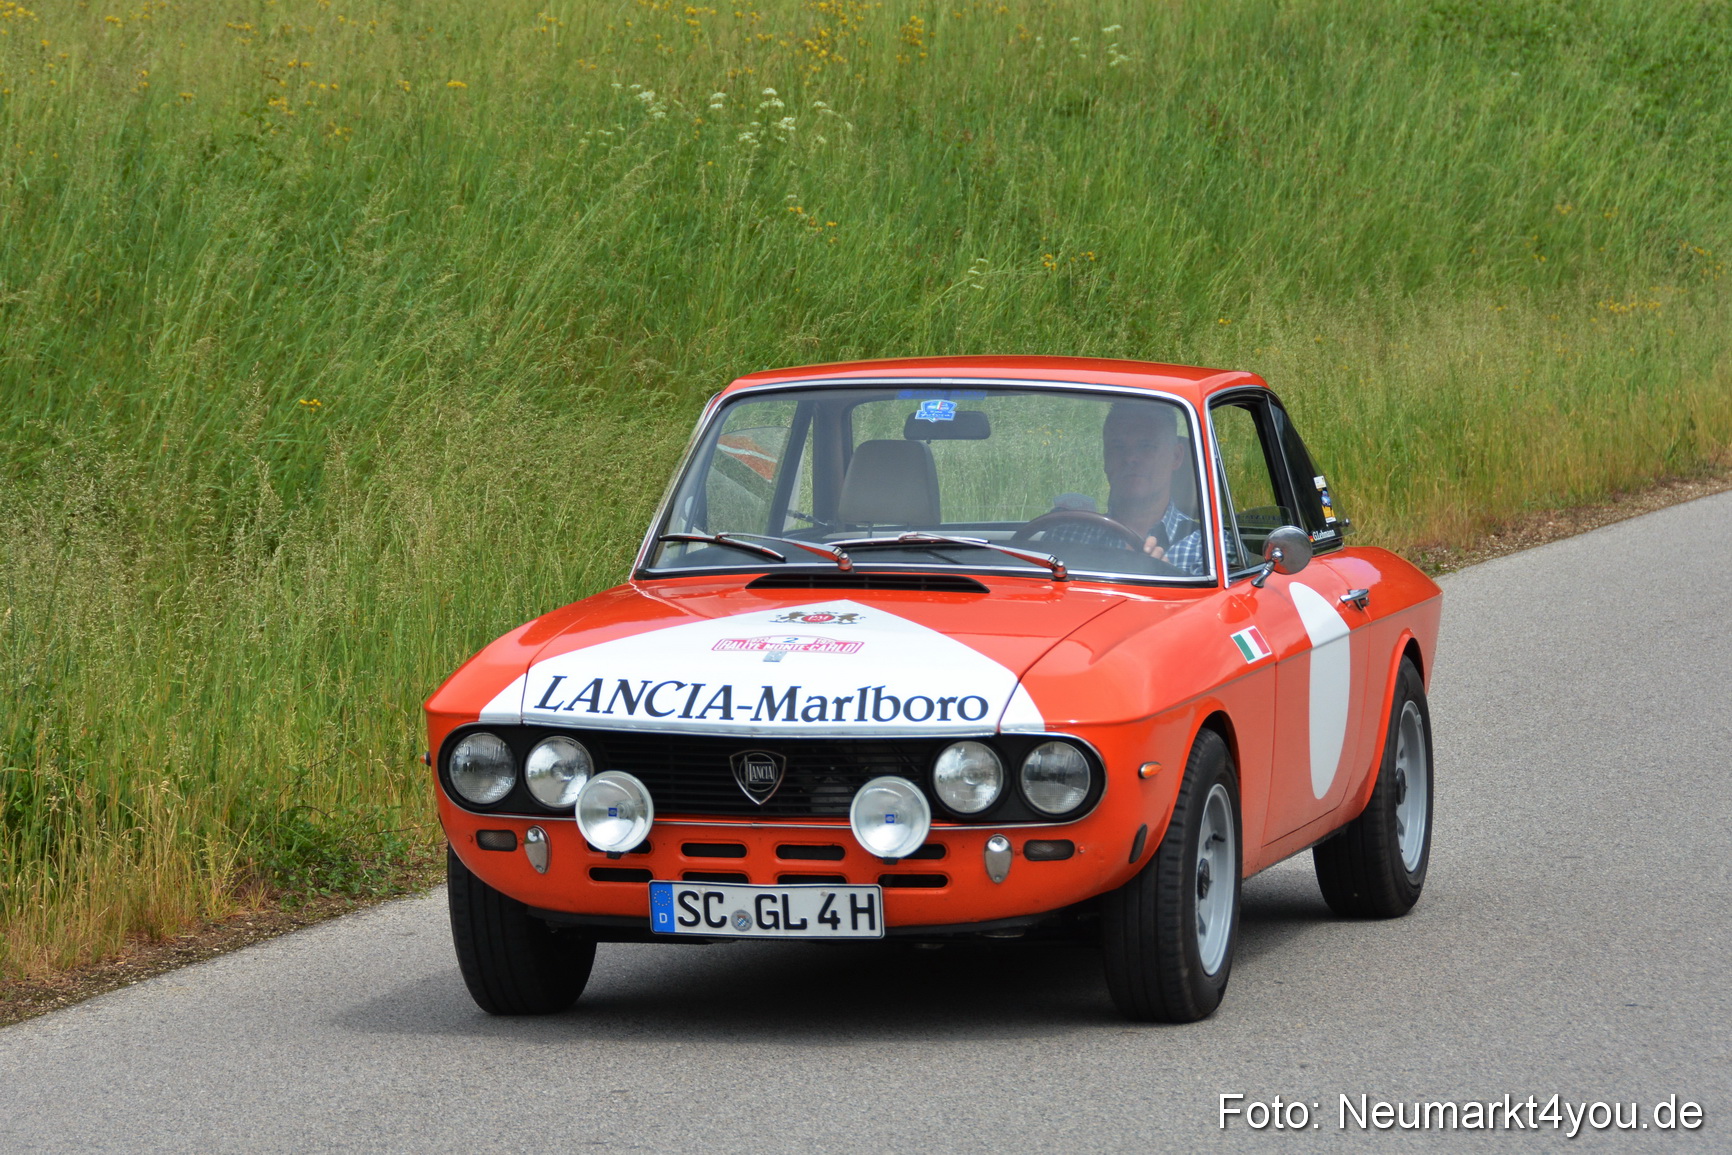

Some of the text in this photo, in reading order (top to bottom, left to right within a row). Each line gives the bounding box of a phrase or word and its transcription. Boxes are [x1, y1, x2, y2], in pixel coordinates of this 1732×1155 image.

[721, 640, 763, 650] RALLYE
[534, 675, 989, 722] LANCIA-Marlboro
[749, 763, 773, 781] LANCIA
[659, 912, 667, 924] D
[678, 890, 727, 928] SC
[755, 893, 807, 930] GL
